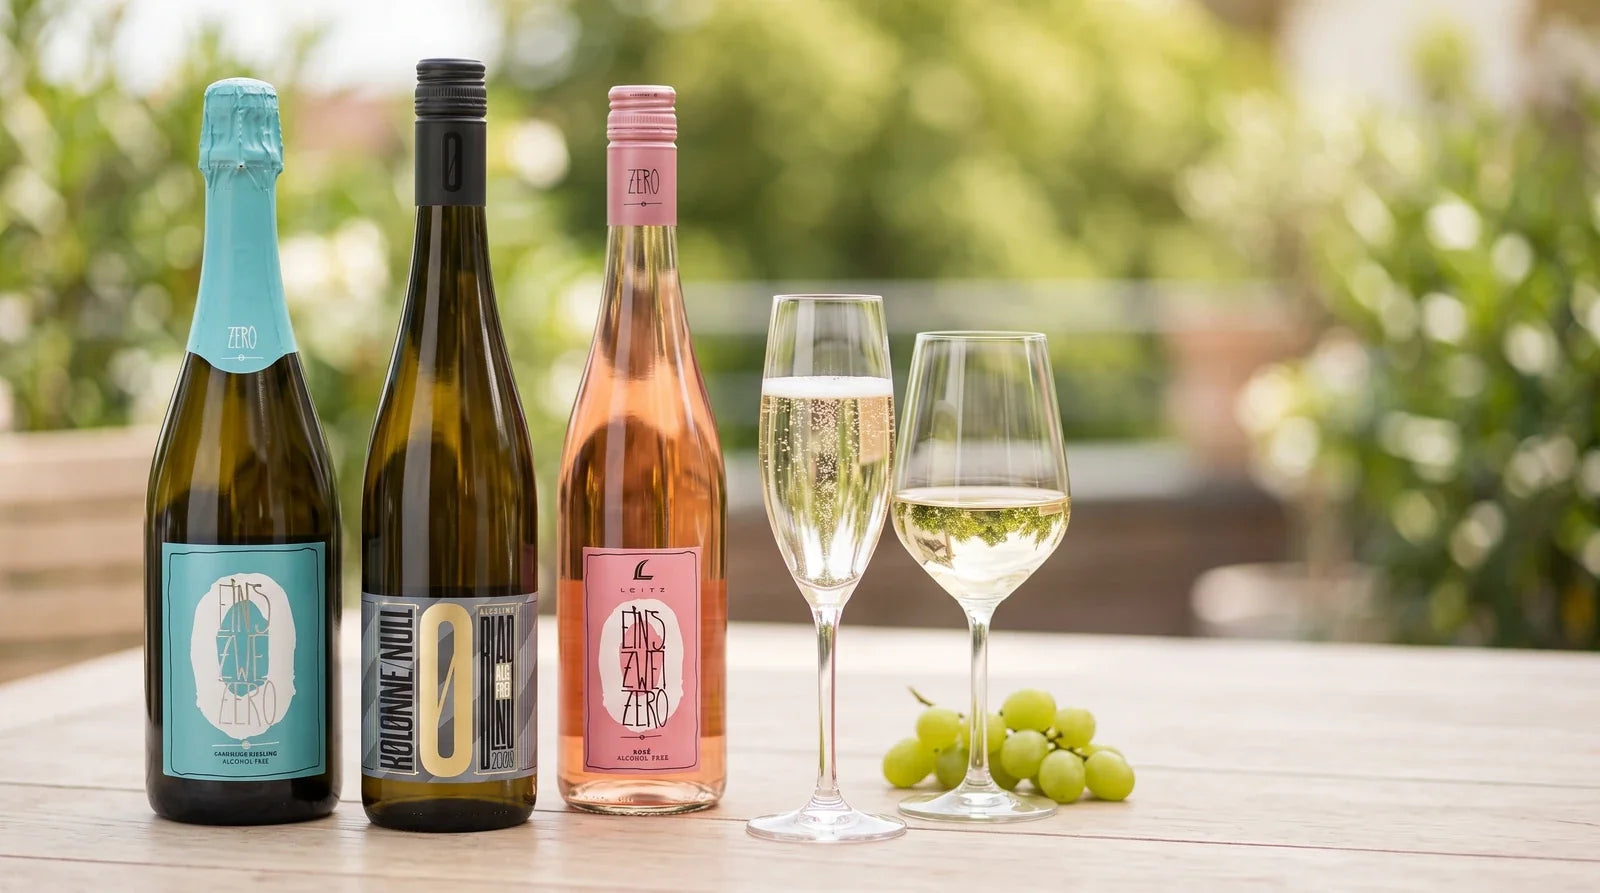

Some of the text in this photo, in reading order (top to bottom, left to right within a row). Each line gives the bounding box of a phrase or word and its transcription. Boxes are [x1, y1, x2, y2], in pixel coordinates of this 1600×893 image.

[628, 168, 660, 195] ZERO
[227, 325, 257, 350] ZERO
[621, 650, 666, 690] ZWEI
[218, 679, 277, 728] ZERO
[621, 689, 669, 729] ZERO
